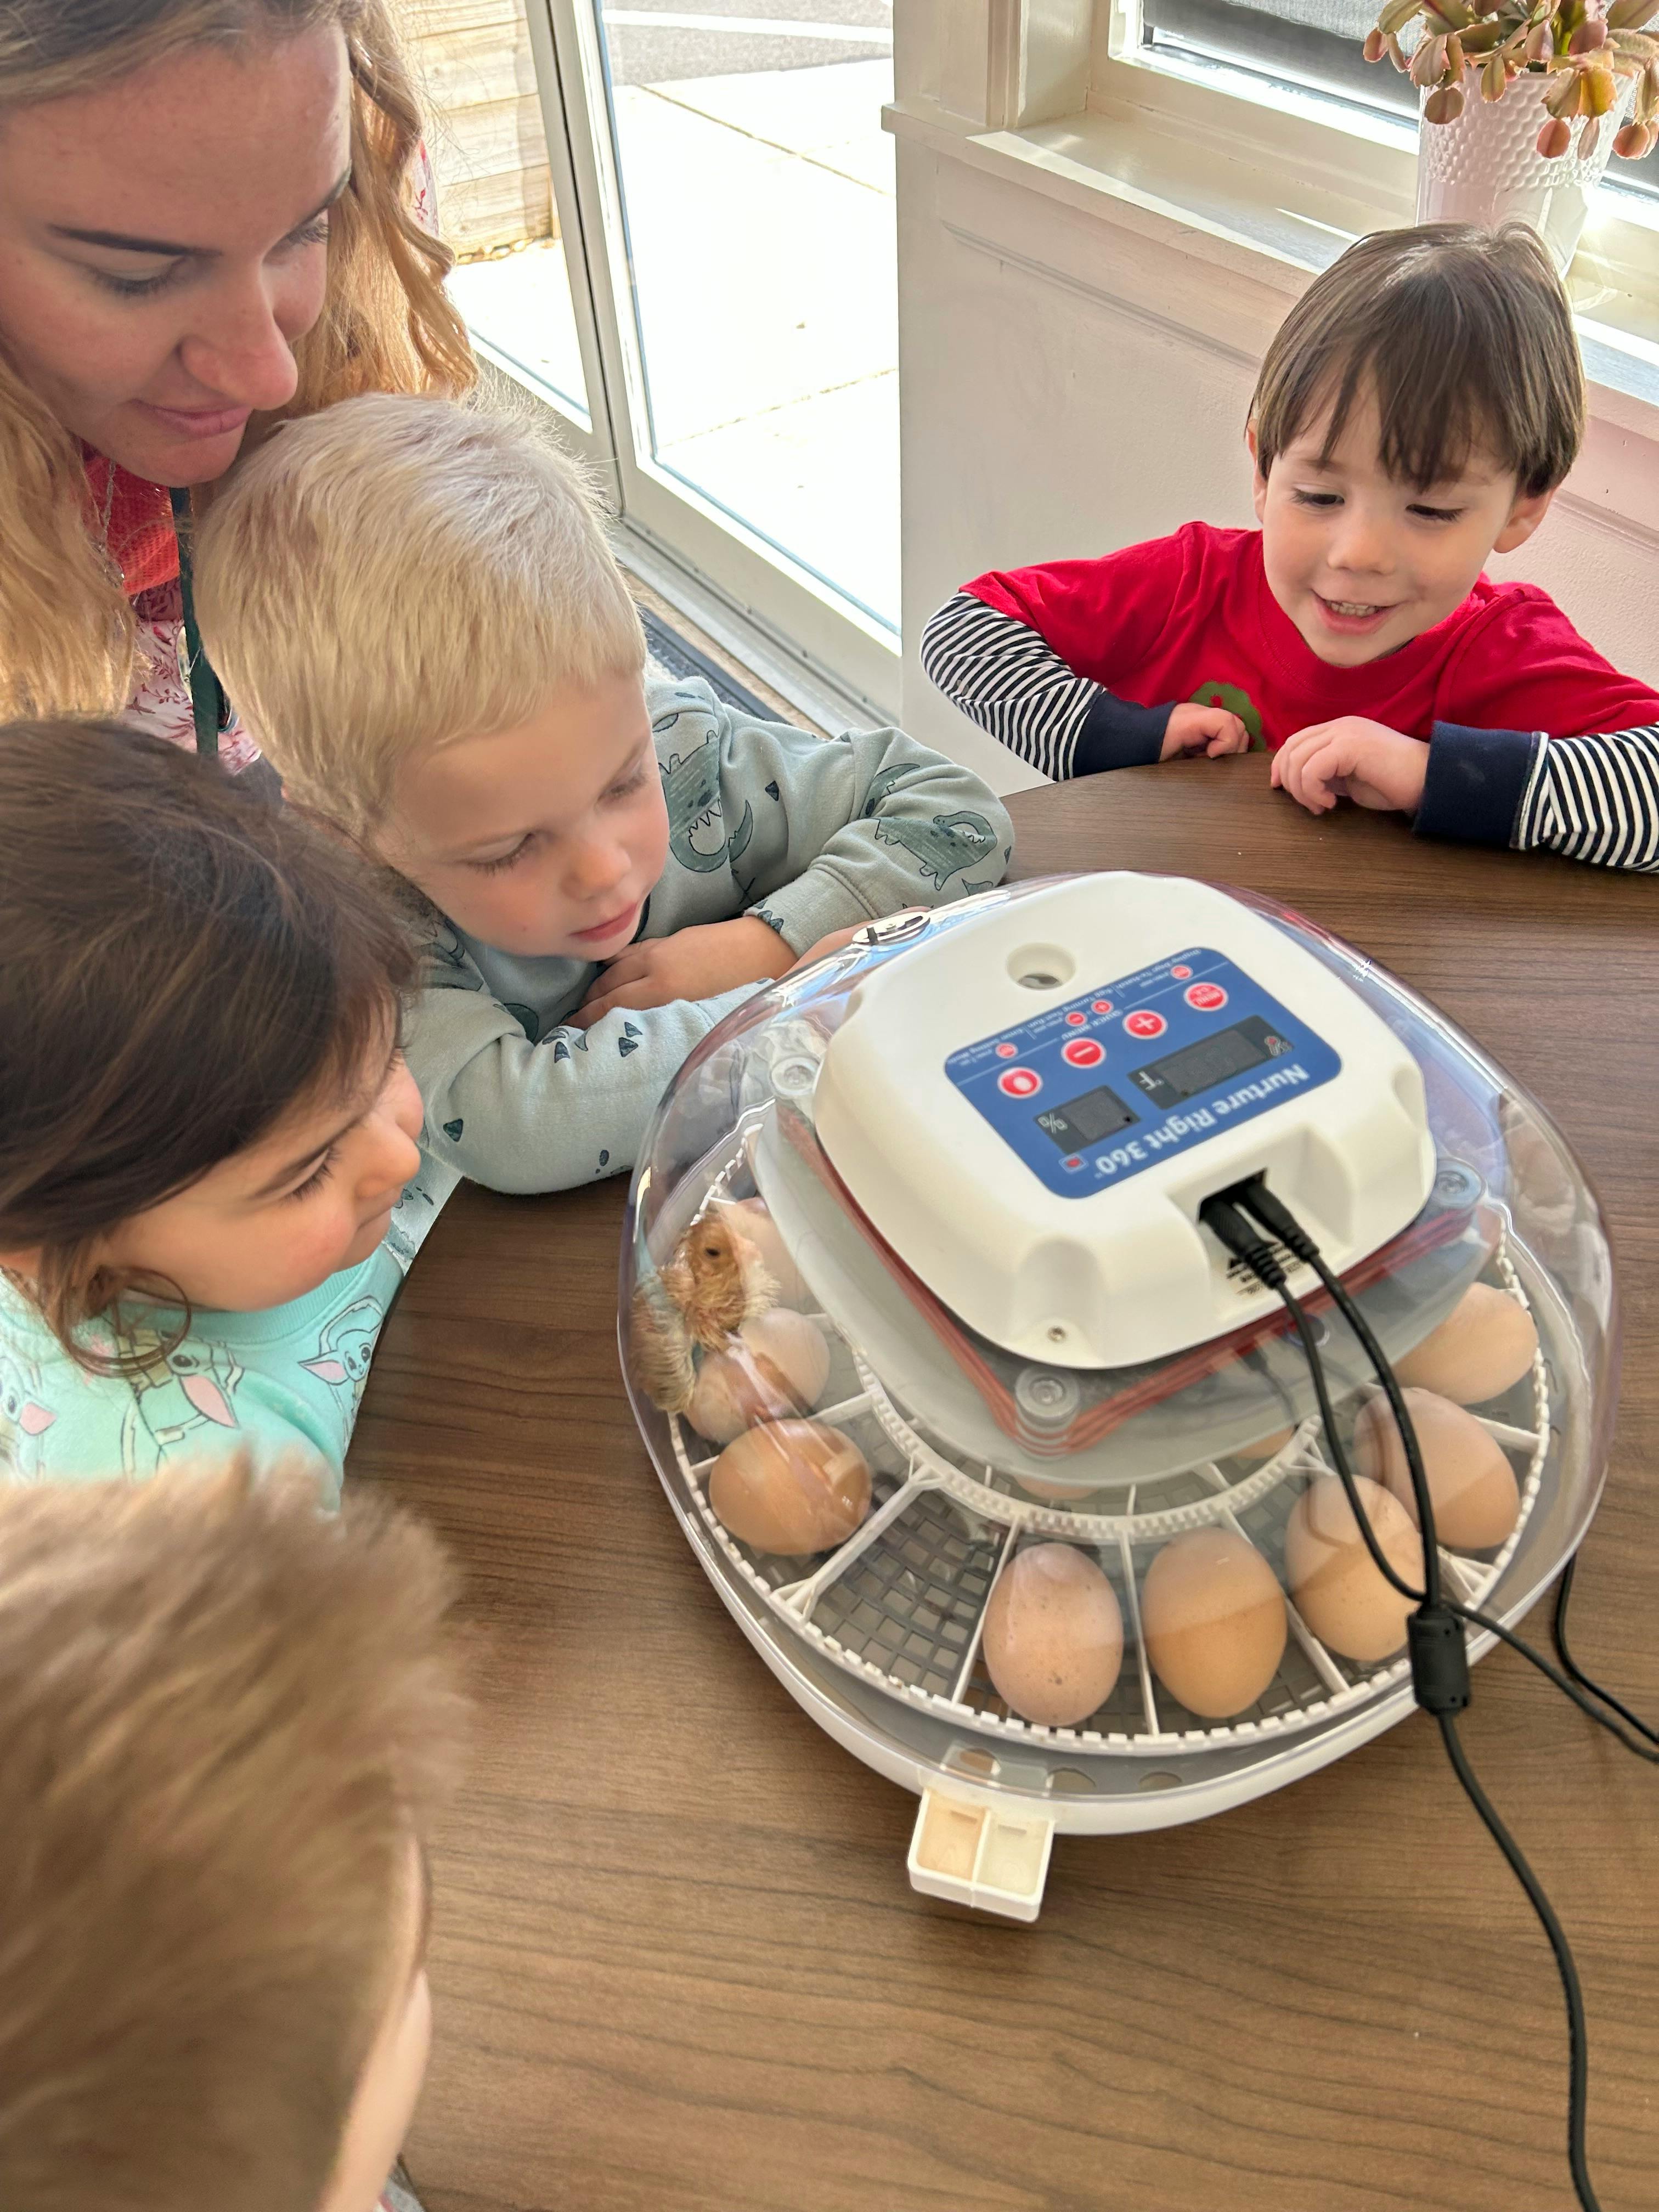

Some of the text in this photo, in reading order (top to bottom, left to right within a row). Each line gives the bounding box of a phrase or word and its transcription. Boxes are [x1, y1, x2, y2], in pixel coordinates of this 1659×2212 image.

[1090, 1008, 1125, 1026] QUICK
[1059, 1023, 1093, 1040] MENU
[1036, 1110, 1069, 1136] %
[1092, 1062, 1311, 1176] Nurture Right 360
